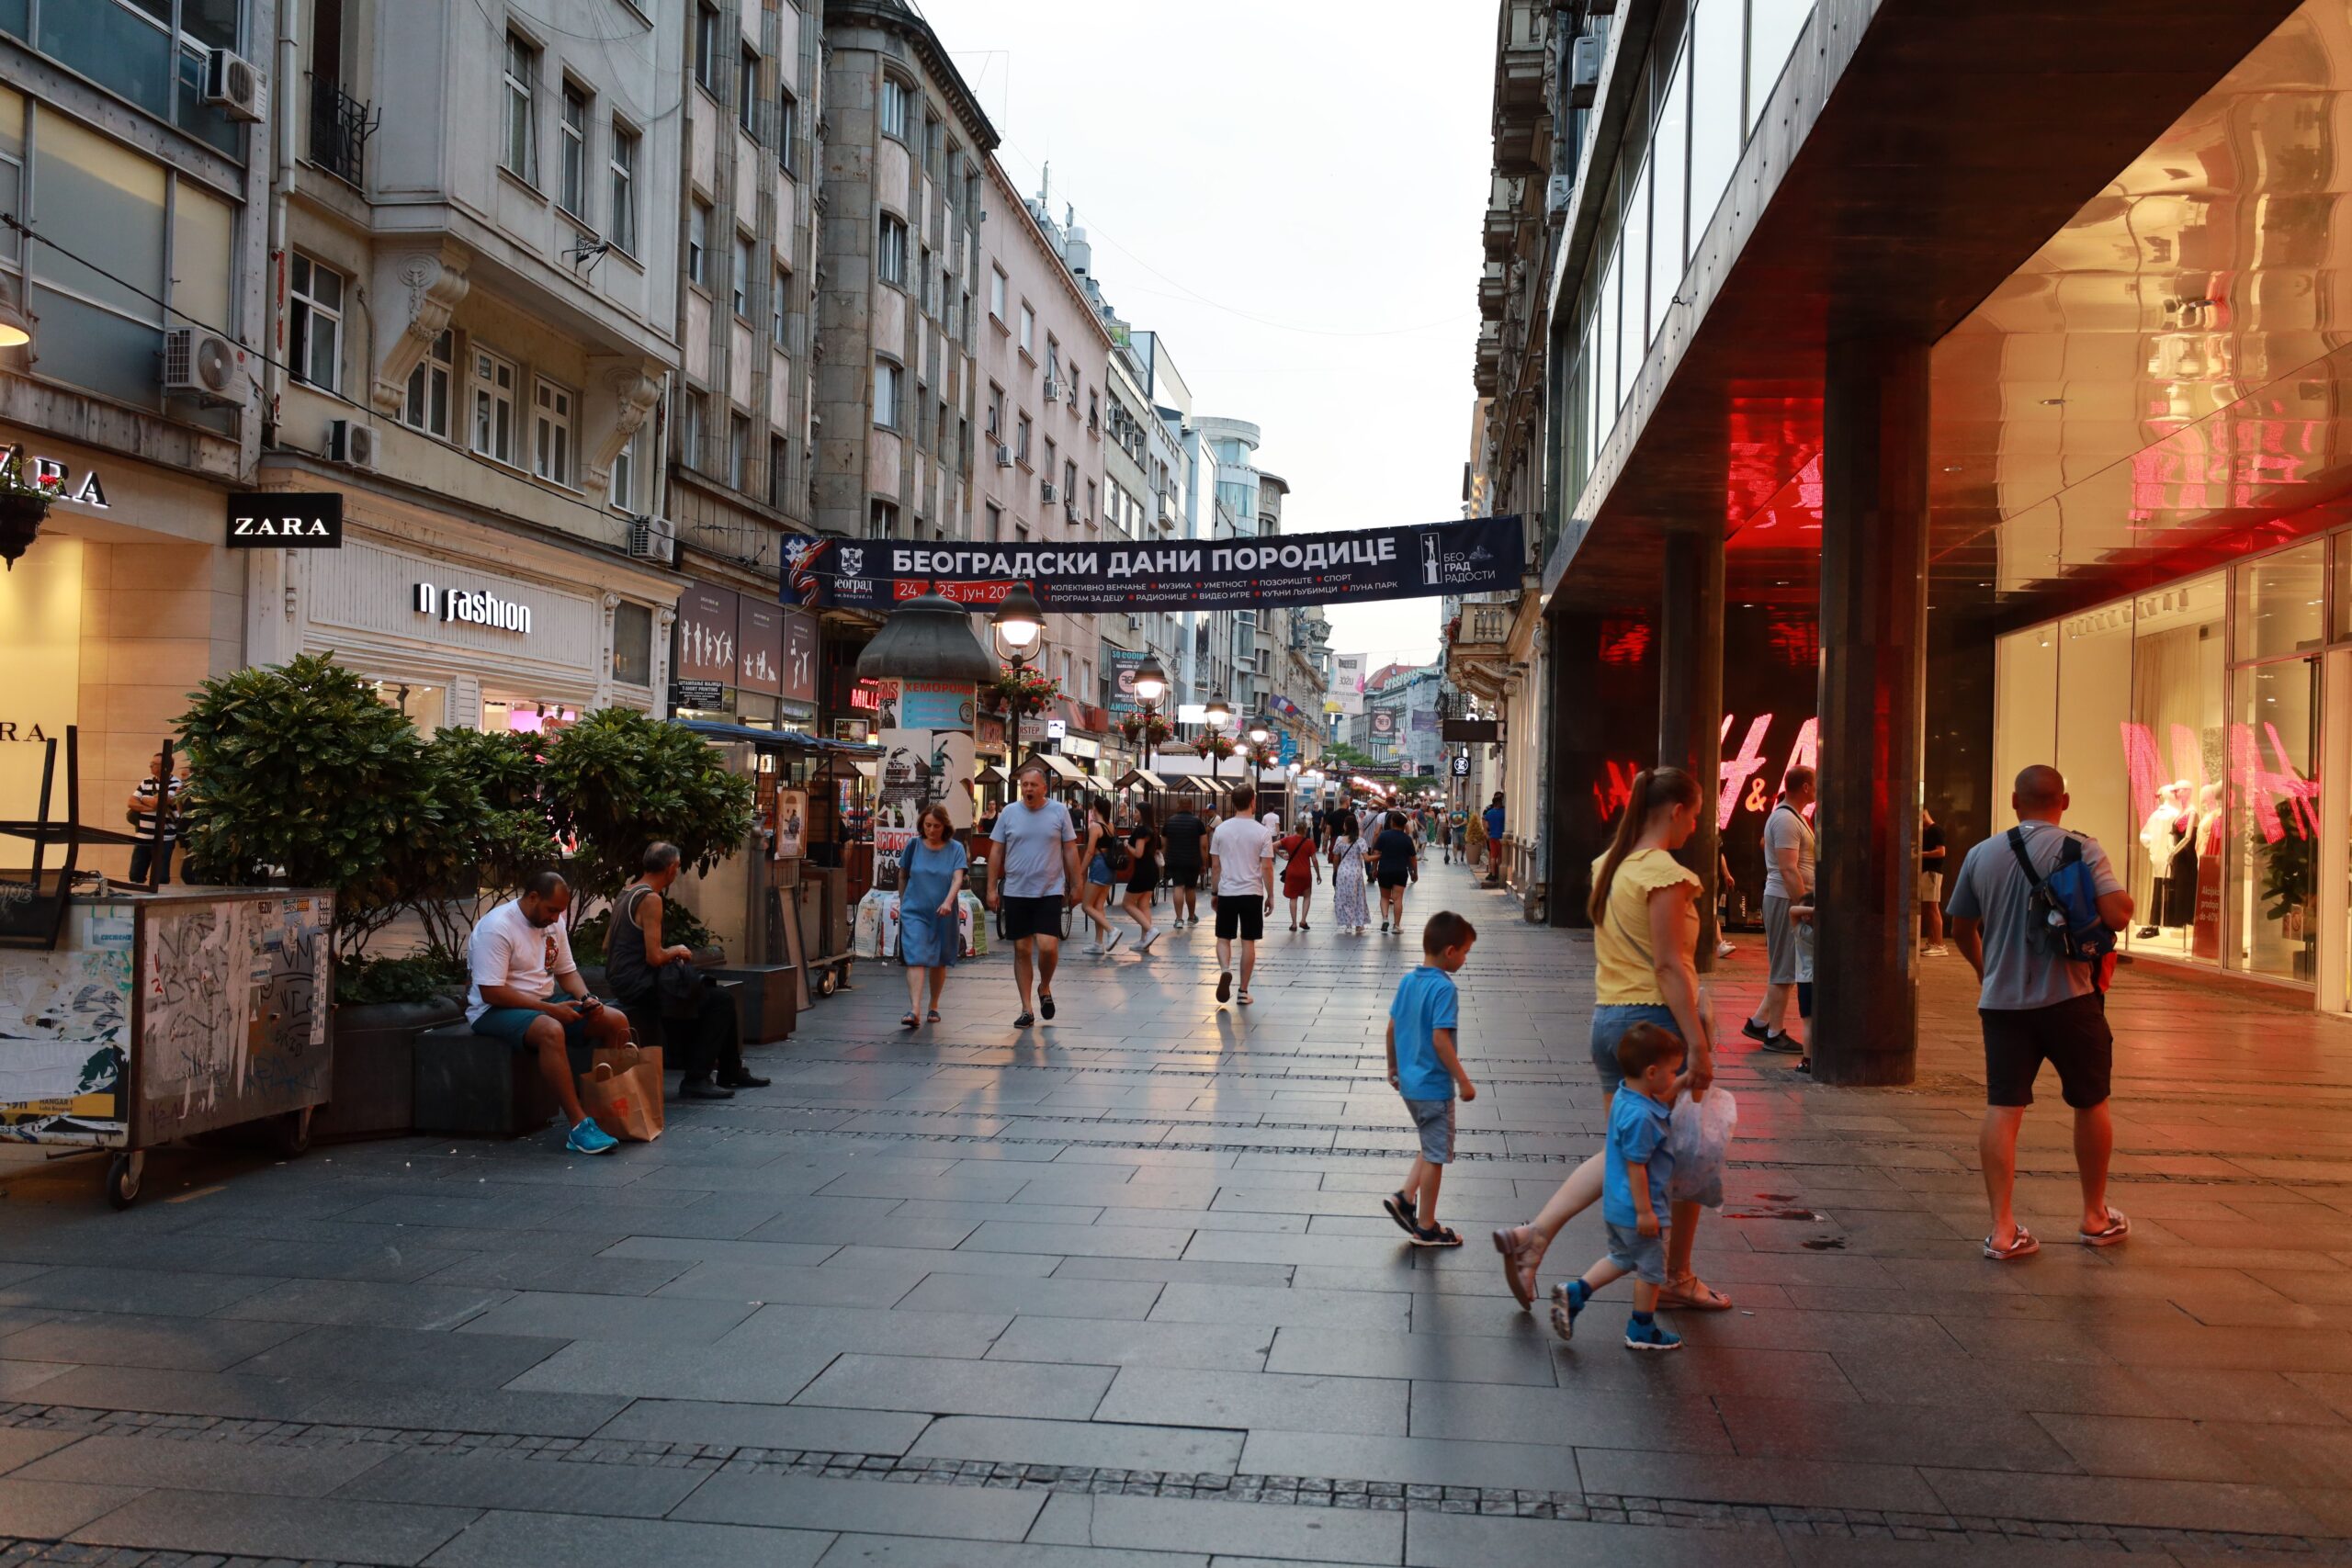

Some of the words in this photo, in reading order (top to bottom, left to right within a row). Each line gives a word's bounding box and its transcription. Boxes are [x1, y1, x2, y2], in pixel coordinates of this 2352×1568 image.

[234, 517, 330, 536] ZARA
[893, 550, 1098, 579] БЕОГРАДСКИ
[1107, 549, 1201, 578] ДАНИ
[1212, 536, 1397, 572] ПОРОДИЦЕ
[1443, 552, 1465, 562] БЕО
[1444, 561, 1471, 572] ГРАД
[1050, 582, 1104, 592] КОЛЕКТИВНО
[1105, 582, 1147, 592] ВЕНЧАЊЕ
[1158, 581, 1193, 591] МУЗИКА
[1203, 580, 1248, 589] УМЕТНОСТ
[1259, 577, 1313, 587] ПОЗОРИШТЕ
[1323, 573, 1352, 582] СПОРТ
[1444, 570, 1496, 583] РАДОСТИ
[938, 584, 959, 598] 25.
[1050, 594, 1089, 603] ПРОГРАМ
[1102, 594, 1125, 604] ДЕЦУ
[1136, 592, 1188, 602] РАДИОНИЦЕ
[1199, 592, 1228, 601] ВИДЕО
[1229, 591, 1250, 599] ИГРЕ
[1261, 589, 1292, 598] КУЋНИ
[1292, 586, 1338, 597] ЉУБИМЦИ
[1349, 583, 1374, 592] ЛУНА
[1374, 581, 1398, 591] ПАРК
[442, 589, 531, 634] fashion
